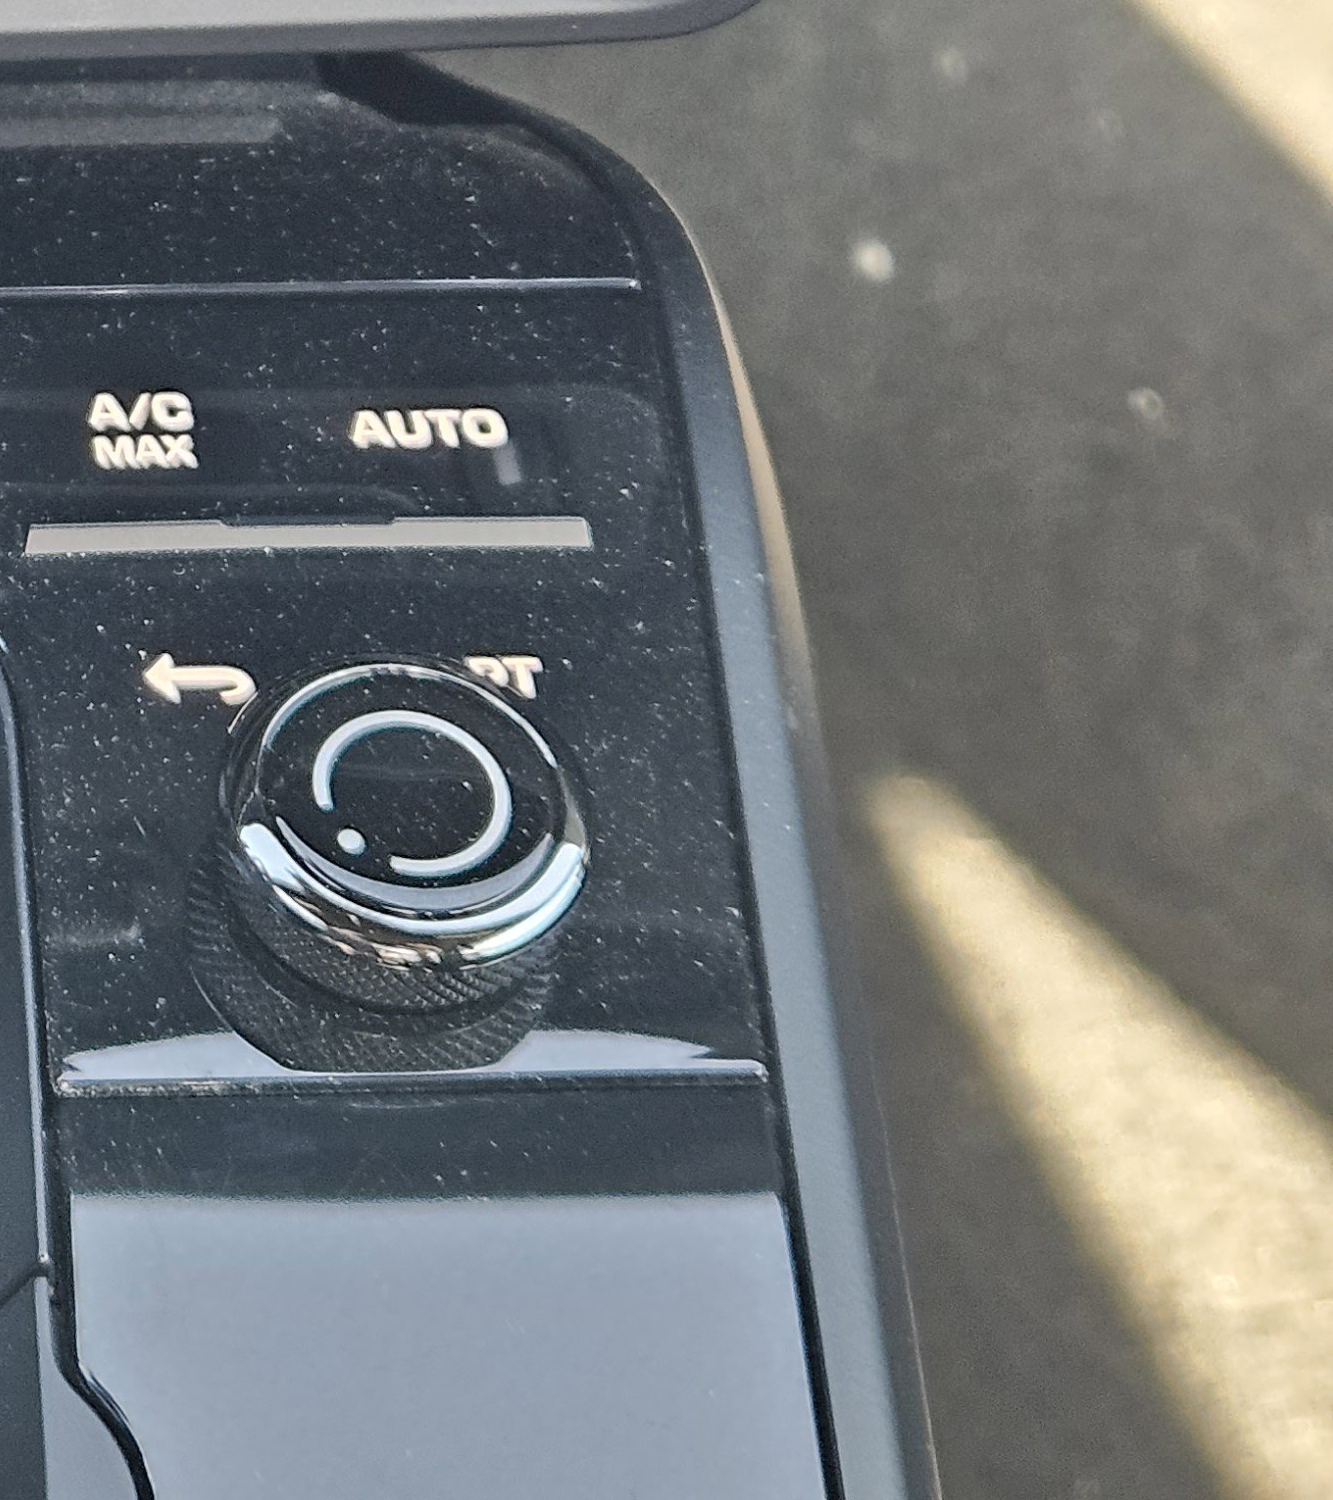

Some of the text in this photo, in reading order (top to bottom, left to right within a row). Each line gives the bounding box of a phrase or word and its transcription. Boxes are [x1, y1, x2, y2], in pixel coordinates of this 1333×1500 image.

[87, 391, 194, 433] A/C
[349, 407, 509, 450] AUTO
[91, 433, 199, 469] MAX
